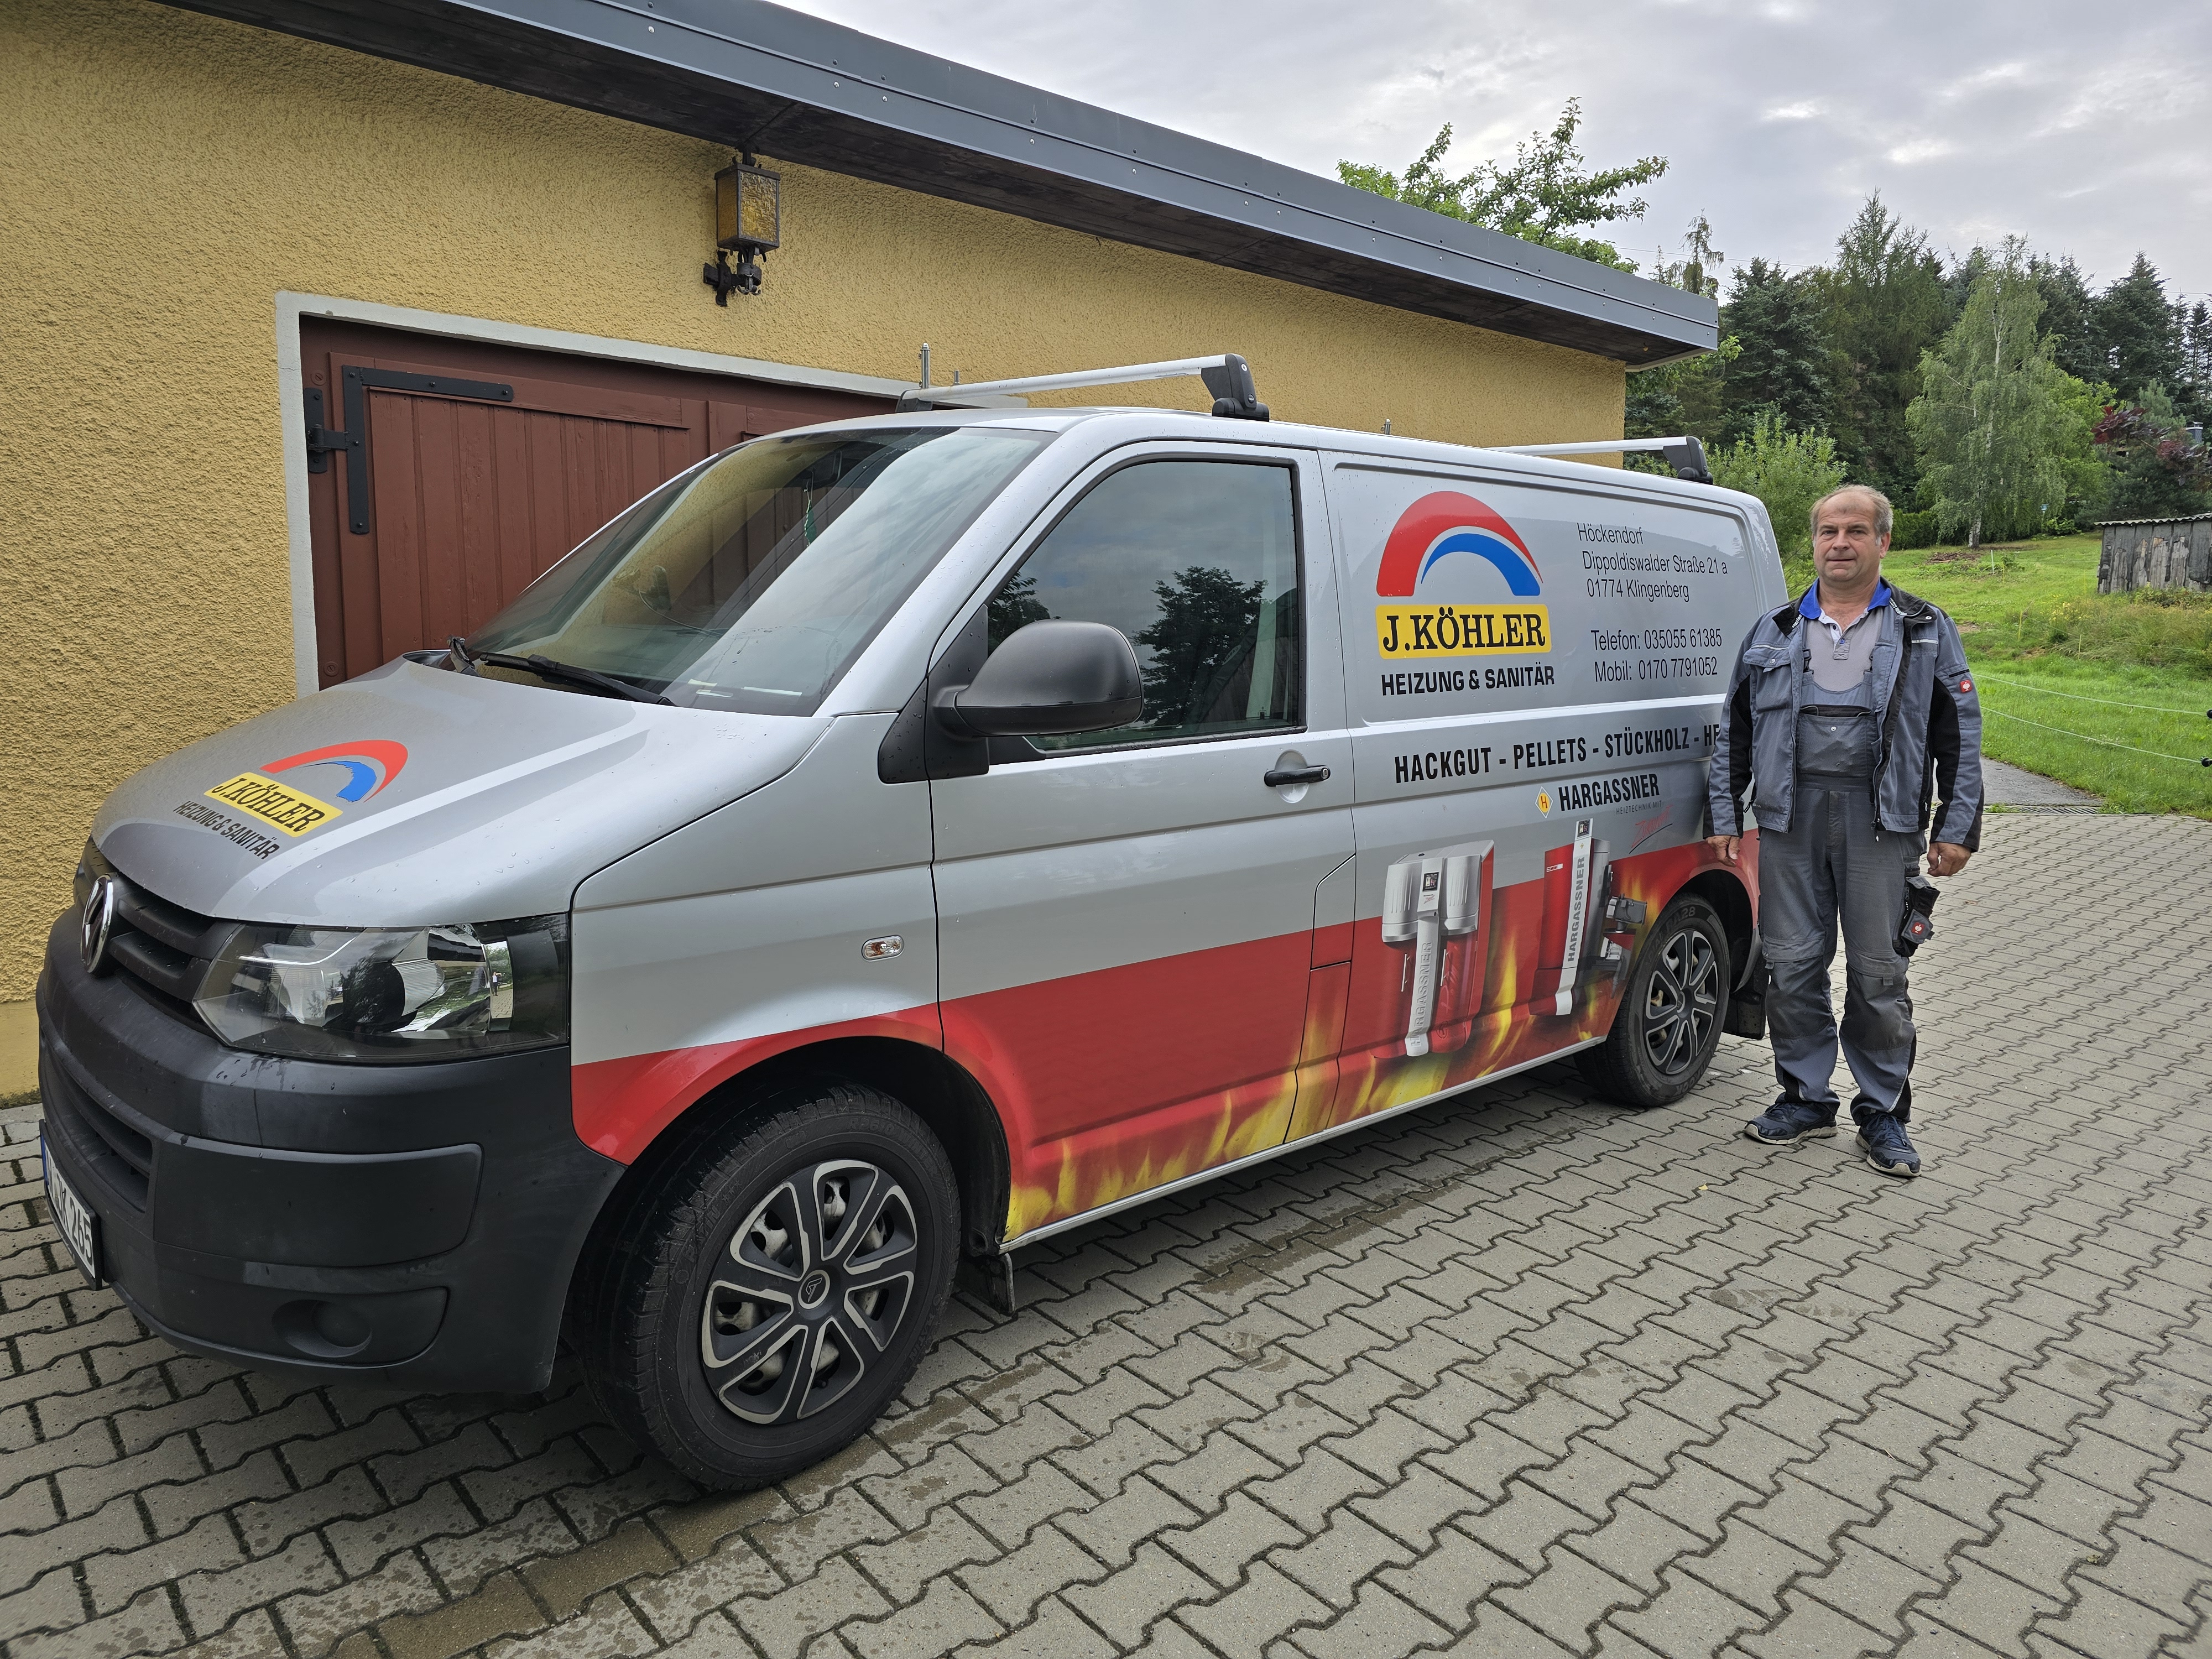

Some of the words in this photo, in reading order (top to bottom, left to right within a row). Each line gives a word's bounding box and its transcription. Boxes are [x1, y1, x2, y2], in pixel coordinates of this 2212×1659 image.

[1577, 523, 1644, 545] Höckendorf
[1583, 551, 1671, 575] Dippoldiswalder
[1673, 555, 1705, 574] Straße
[1708, 557, 1719, 574] 21
[1721, 562, 1728, 575] a
[1587, 578, 1623, 597] 01774
[1626, 580, 1689, 603] Klingenberg
[1383, 607, 1546, 652] J.KÖHLER
[1591, 629, 1641, 651] Telefon:
[1645, 629, 1687, 649] 035055
[1690, 628, 1722, 648] 61385
[1381, 670, 1464, 696] HEIZUNG
[1469, 670, 1479, 690] &
[1485, 662, 1554, 688] SANITÄR
[1594, 660, 1632, 682] Mobil:
[1639, 660, 1668, 680] 0170
[1671, 656, 1718, 678] 7791052
[1394, 747, 1491, 784] HACKGUT
[1514, 737, 1587, 769] PELLETS
[1605, 727, 1689, 758] STÜCKHOLZ
[211, 778, 325, 832] J.KÖHLER
[1558, 773, 1660, 811] HARGASSNER
[1616, 803, 1651, 815] HEIZTECHNIK
[173, 800, 224, 827] HEIZUNG
[211, 818, 232, 831] &
[220, 823, 280, 860] SANITÄR
[1567, 857, 1585, 962] HARGASSNER
[1411, 942, 1432, 1047] HARGASSNER
[70, 1197, 92, 1266] 265
